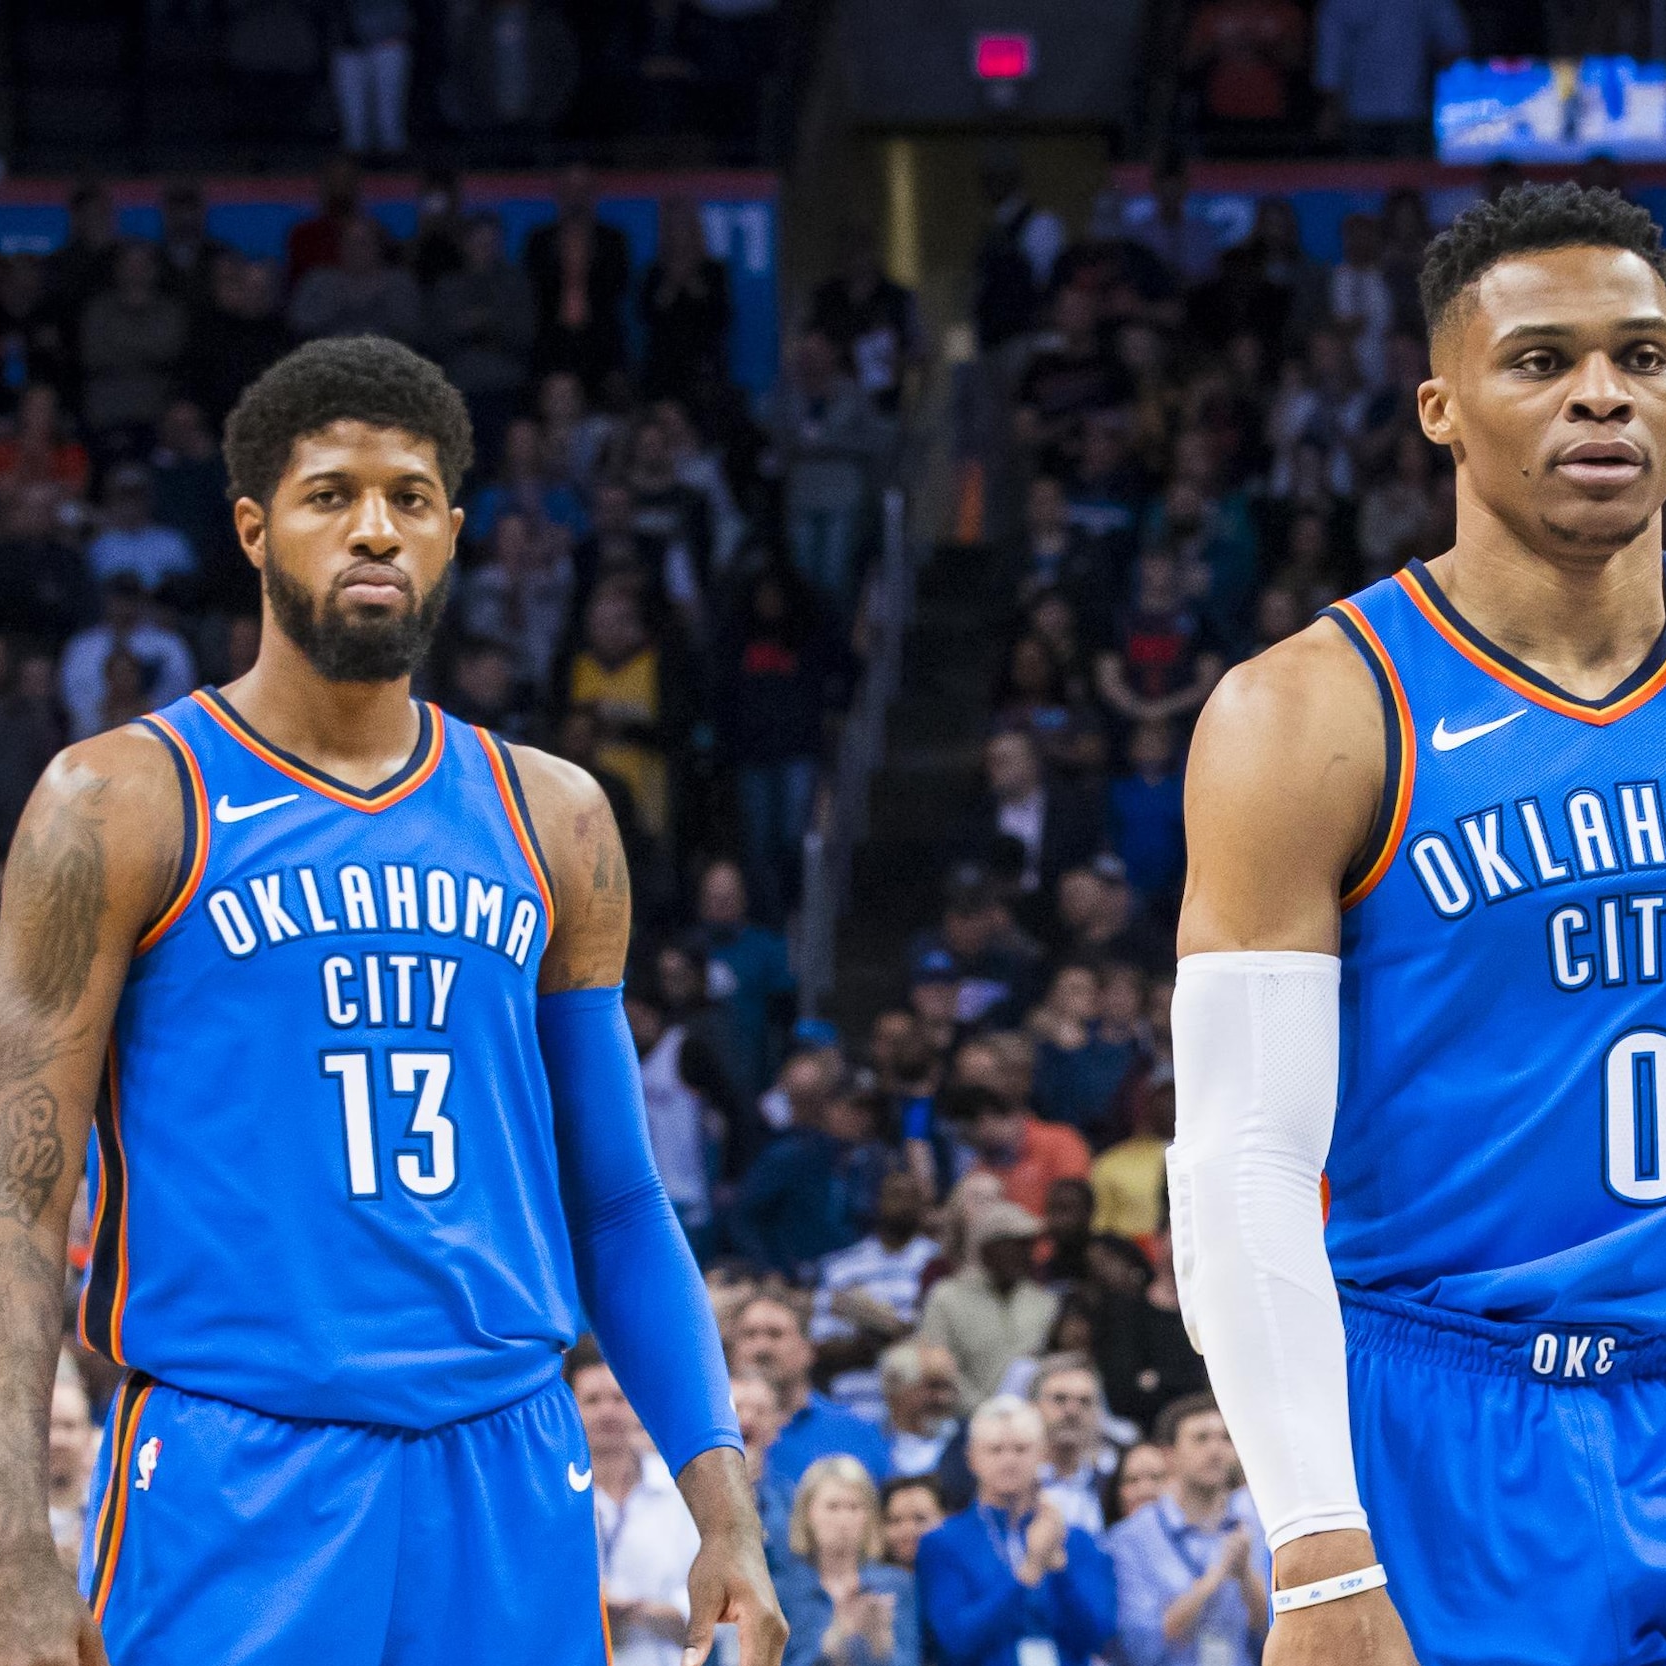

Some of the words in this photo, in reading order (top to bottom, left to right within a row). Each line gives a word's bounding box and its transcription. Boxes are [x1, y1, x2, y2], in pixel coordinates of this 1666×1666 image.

[203, 860, 542, 969] OKLAHOMA
[319, 952, 461, 1032] CITY
[320, 1049, 458, 1200] 13
